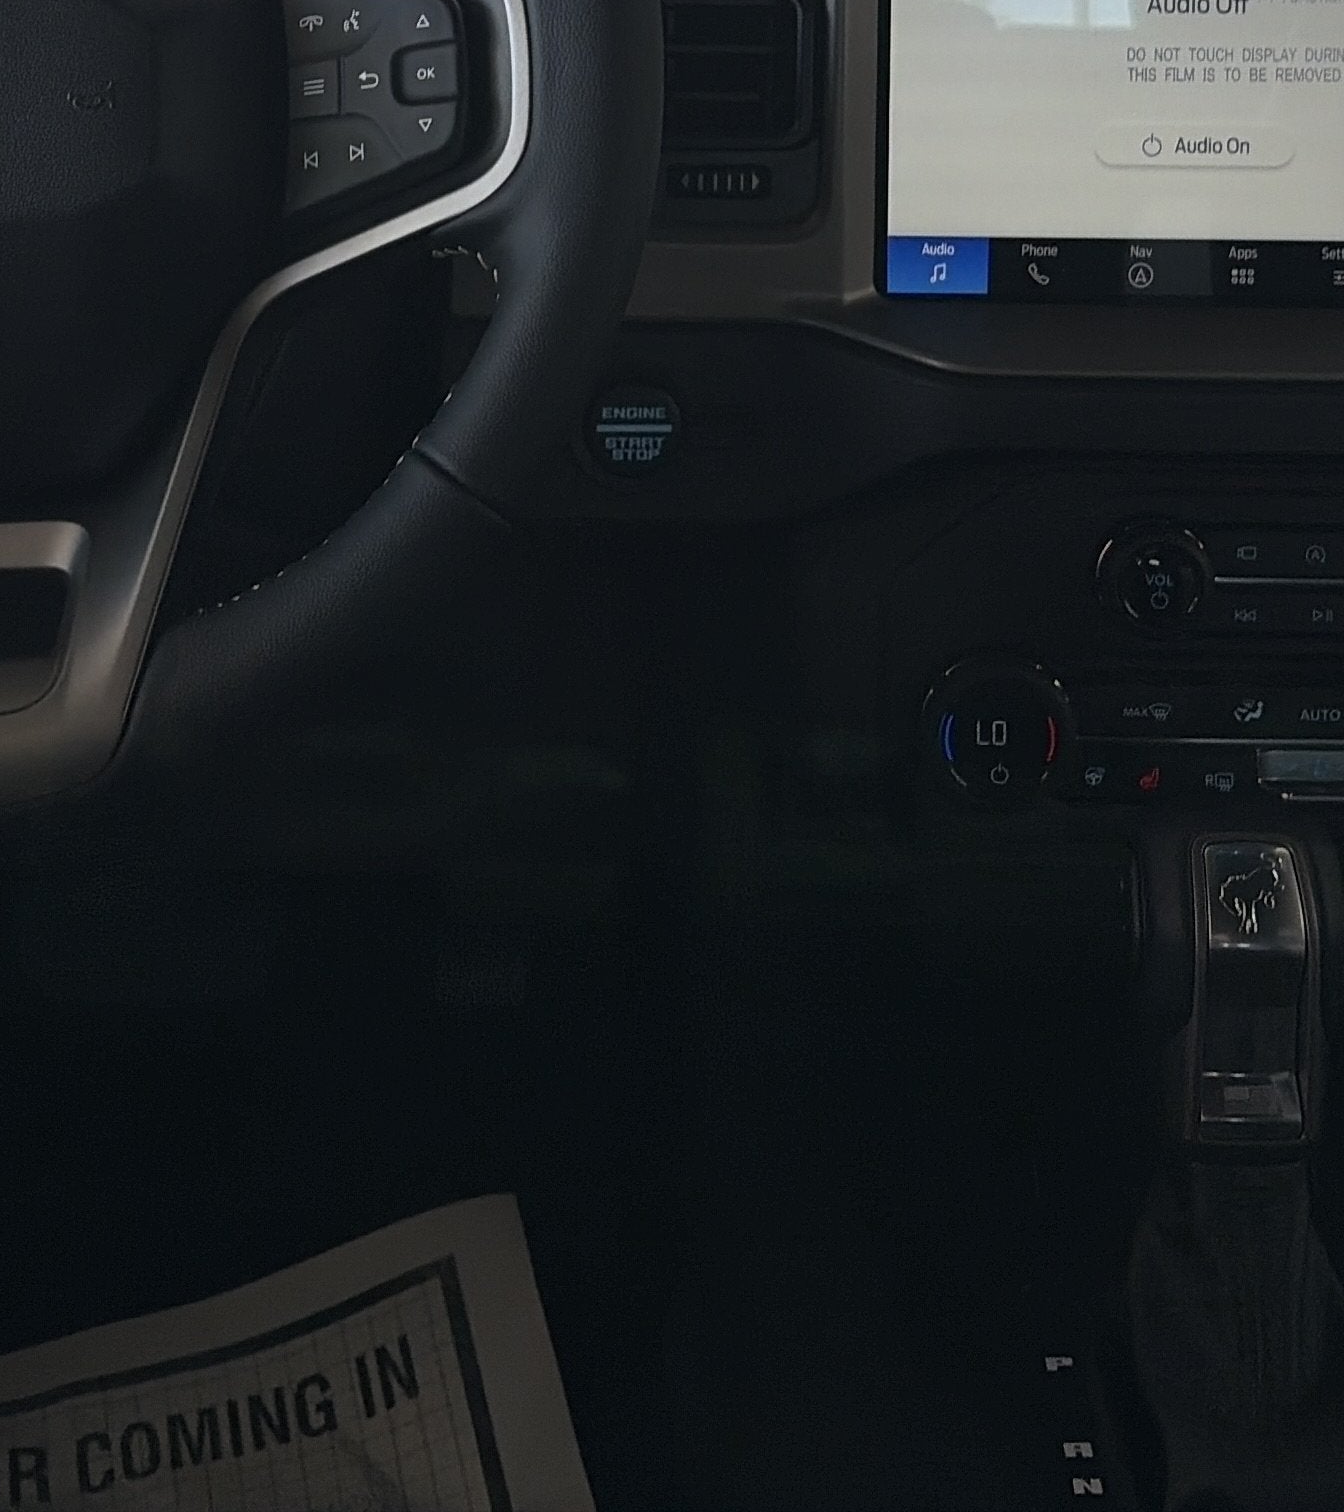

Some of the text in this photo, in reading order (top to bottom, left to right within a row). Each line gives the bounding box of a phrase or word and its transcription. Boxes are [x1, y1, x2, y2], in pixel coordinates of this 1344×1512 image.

[1126, 46, 1147, 62] DO
[1153, 46, 1182, 62] NOT
[1188, 46, 1234, 63] TOUCH
[1241, 46, 1298, 63] DISPLAY
[415, 67, 436, 81] OK
[1126, 67, 1158, 83] THIS
[1163, 67, 1197, 83] FILM
[1202, 67, 1216, 83] IS
[1221, 67, 1242, 83] TO
[1247, 67, 1270, 83] BE
[1275, 67, 1342, 83] REMOVED
[1174, 136, 1250, 155] Audio On
[921, 242, 955, 258] Audio
[1021, 243, 1058, 259] Phone
[1130, 245, 1153, 258] Nav
[1229, 245, 1258, 263] Apps
[601, 406, 667, 420] ENGINE
[605, 436, 665, 449] START
[611, 449, 661, 461] STOP
[1145, 572, 1174, 587] VOL
[1299, 708, 1342, 722] AUTO
[976, 720, 1008, 748] LO
[1044, 1356, 1074, 1372] P
[76, 1370, 341, 1495] COMING
[353, 1333, 422, 1419] IN
[1072, 1477, 1104, 1496] N
